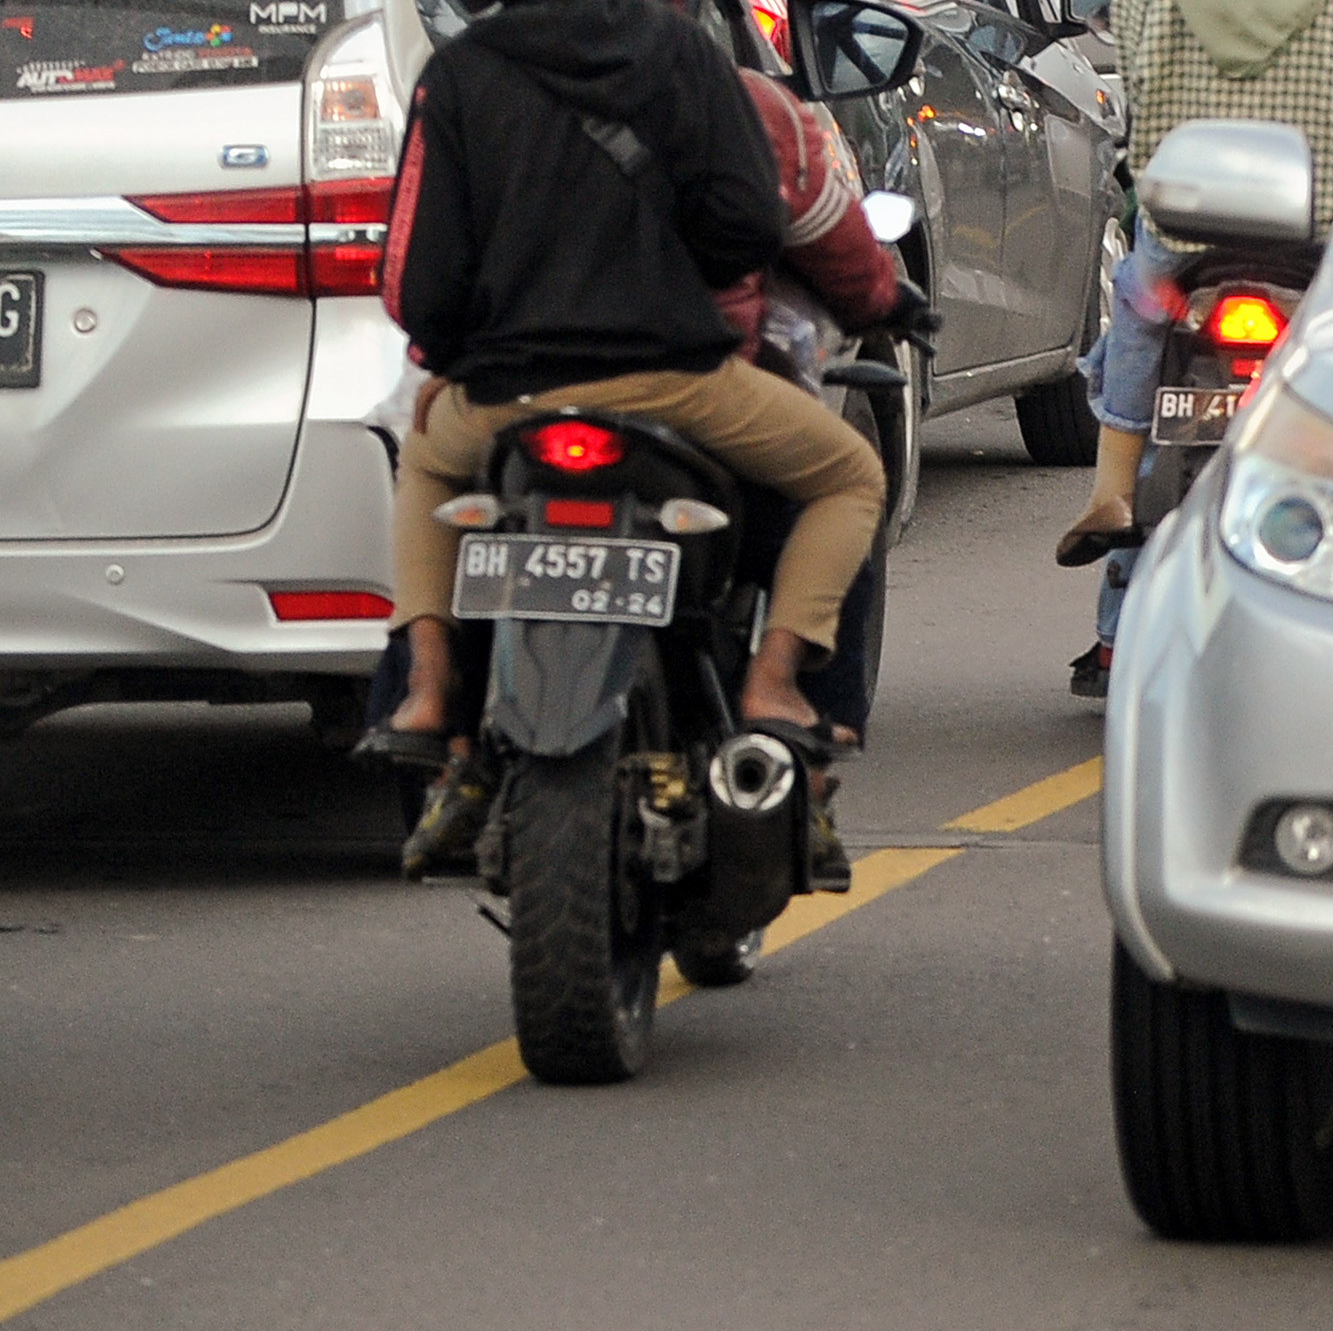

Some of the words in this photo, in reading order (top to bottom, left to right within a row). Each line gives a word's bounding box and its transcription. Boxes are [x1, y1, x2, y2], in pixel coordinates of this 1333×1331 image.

[249, 1, 327, 25] MPM
[1160, 393, 1194, 418] BH
[465, 542, 509, 578] BH
[524, 543, 609, 580] 4557
[625, 547, 667, 584] TS
